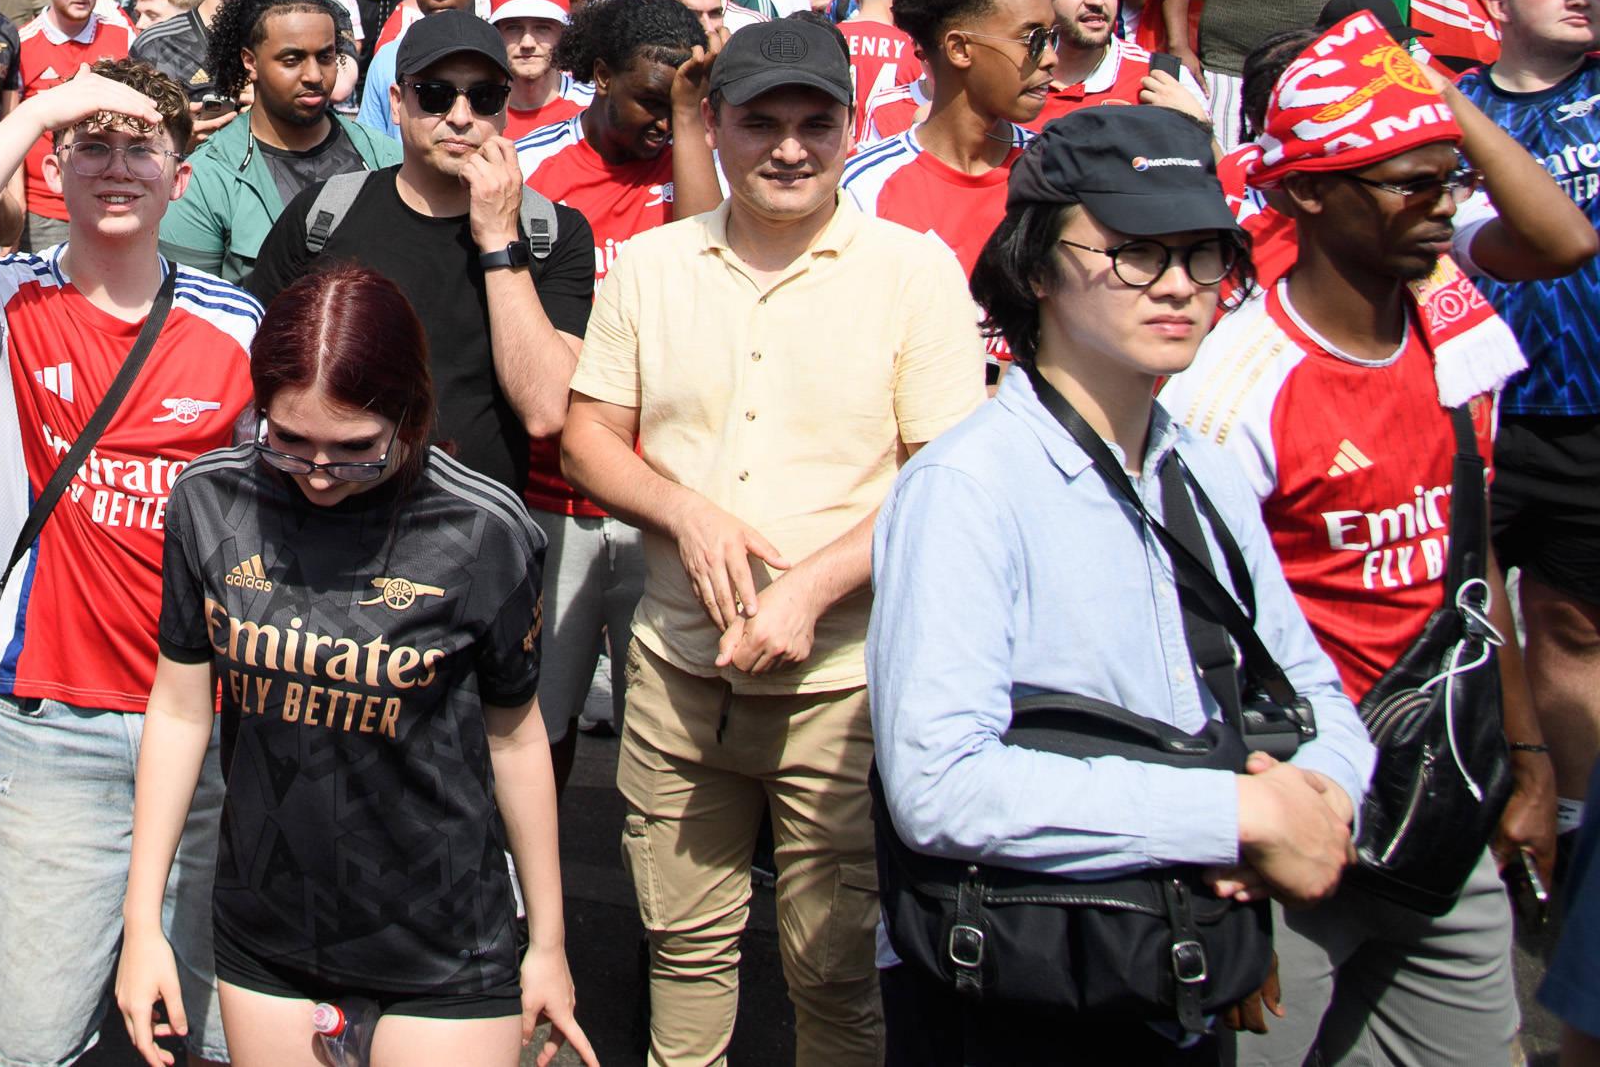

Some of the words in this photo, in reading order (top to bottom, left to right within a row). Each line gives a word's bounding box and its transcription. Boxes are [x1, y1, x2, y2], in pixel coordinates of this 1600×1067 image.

[849, 35, 906, 60] ENRY
[91, 490, 166, 530] BETTE
[1321, 484, 1453, 552] Emir
[225, 572, 273, 592] adidas
[1362, 545, 1414, 589] FLY
[1420, 535, 1450, 581] B
[204, 597, 446, 690] Emirates
[229, 669, 272, 715] FLY
[282, 681, 402, 739] BETTER
